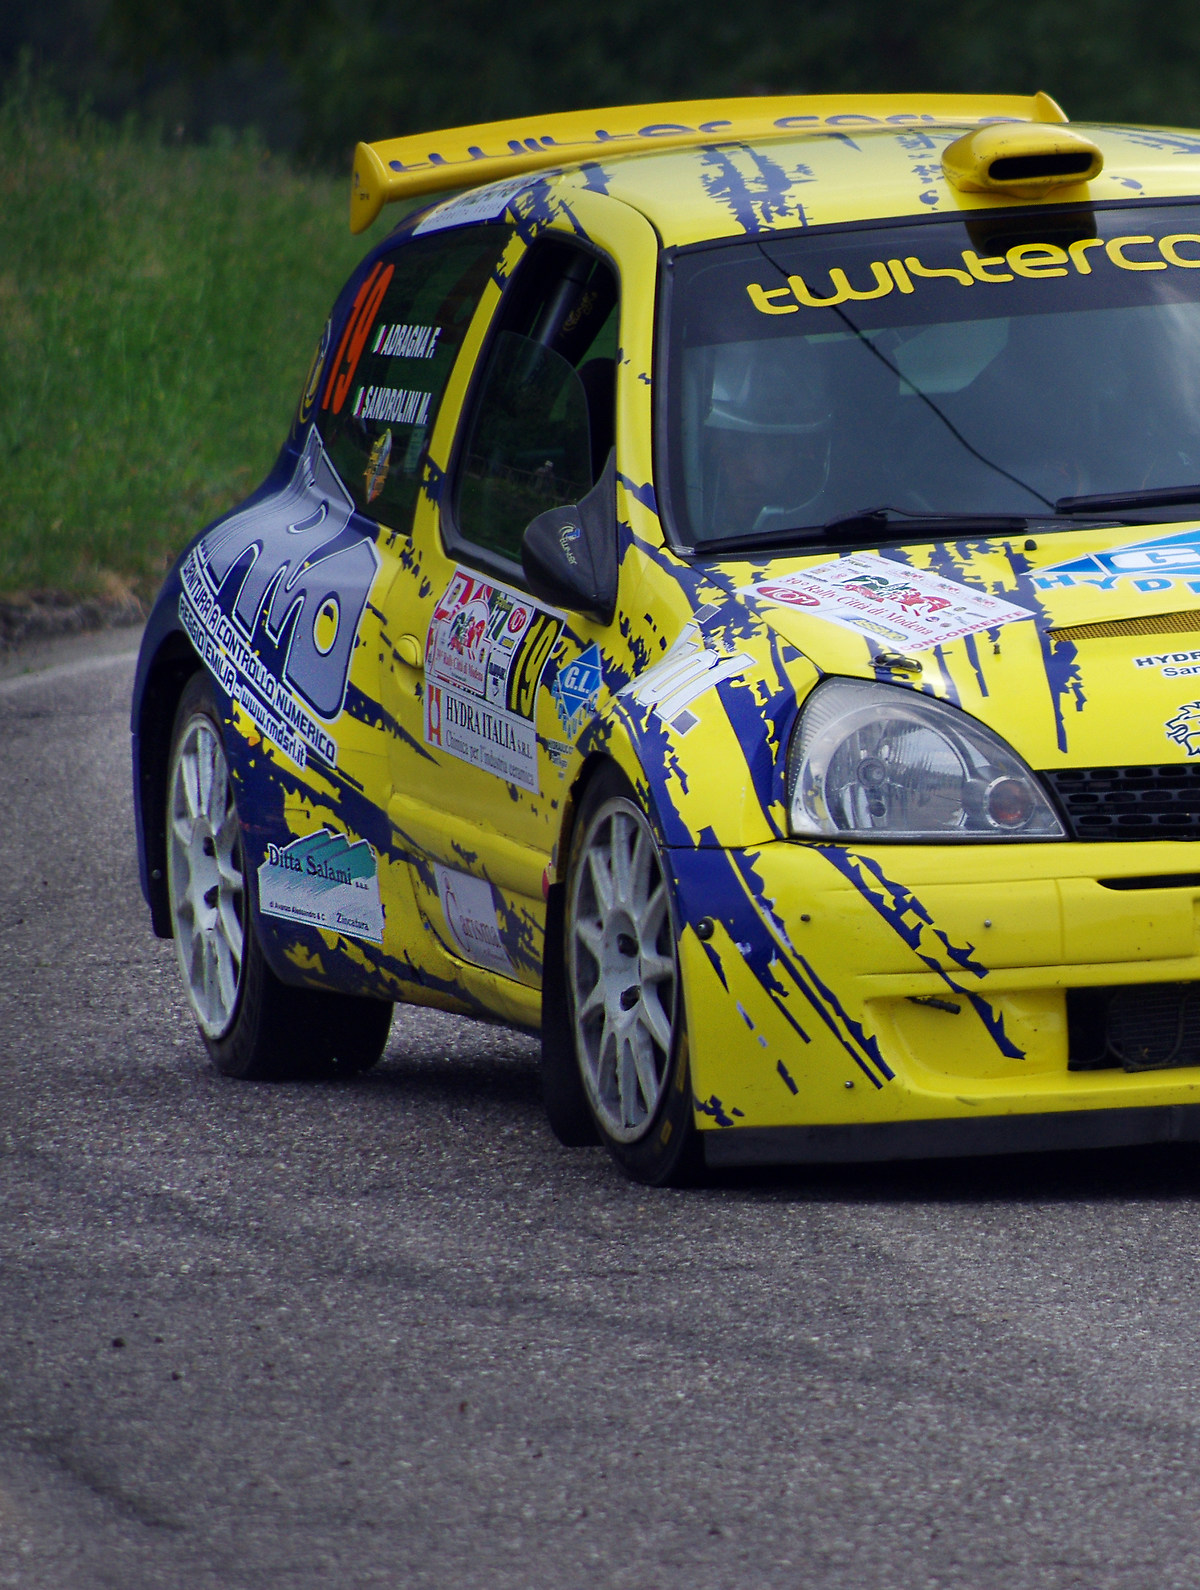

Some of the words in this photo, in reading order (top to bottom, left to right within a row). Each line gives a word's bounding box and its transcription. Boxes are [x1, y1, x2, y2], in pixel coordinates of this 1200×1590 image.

[322, 261, 395, 415] 19
[380, 324, 432, 358] ADRAGNA
[361, 385, 421, 423] SANDROLINI
[882, 611, 935, 636] Modena
[899, 610, 1027, 651] CONCORRENTE
[205, 641, 235, 690] EMILIA
[511, 614, 559, 717] 19
[564, 666, 590, 694] G.L.
[216, 618, 275, 699] CONTROLLO
[276, 691, 335, 762] NUMERICO
[446, 695, 481, 735] HYDRA
[482, 712, 516, 752] ITALIA
[268, 845, 304, 872] Ditta
[306, 855, 353, 886] Salami
